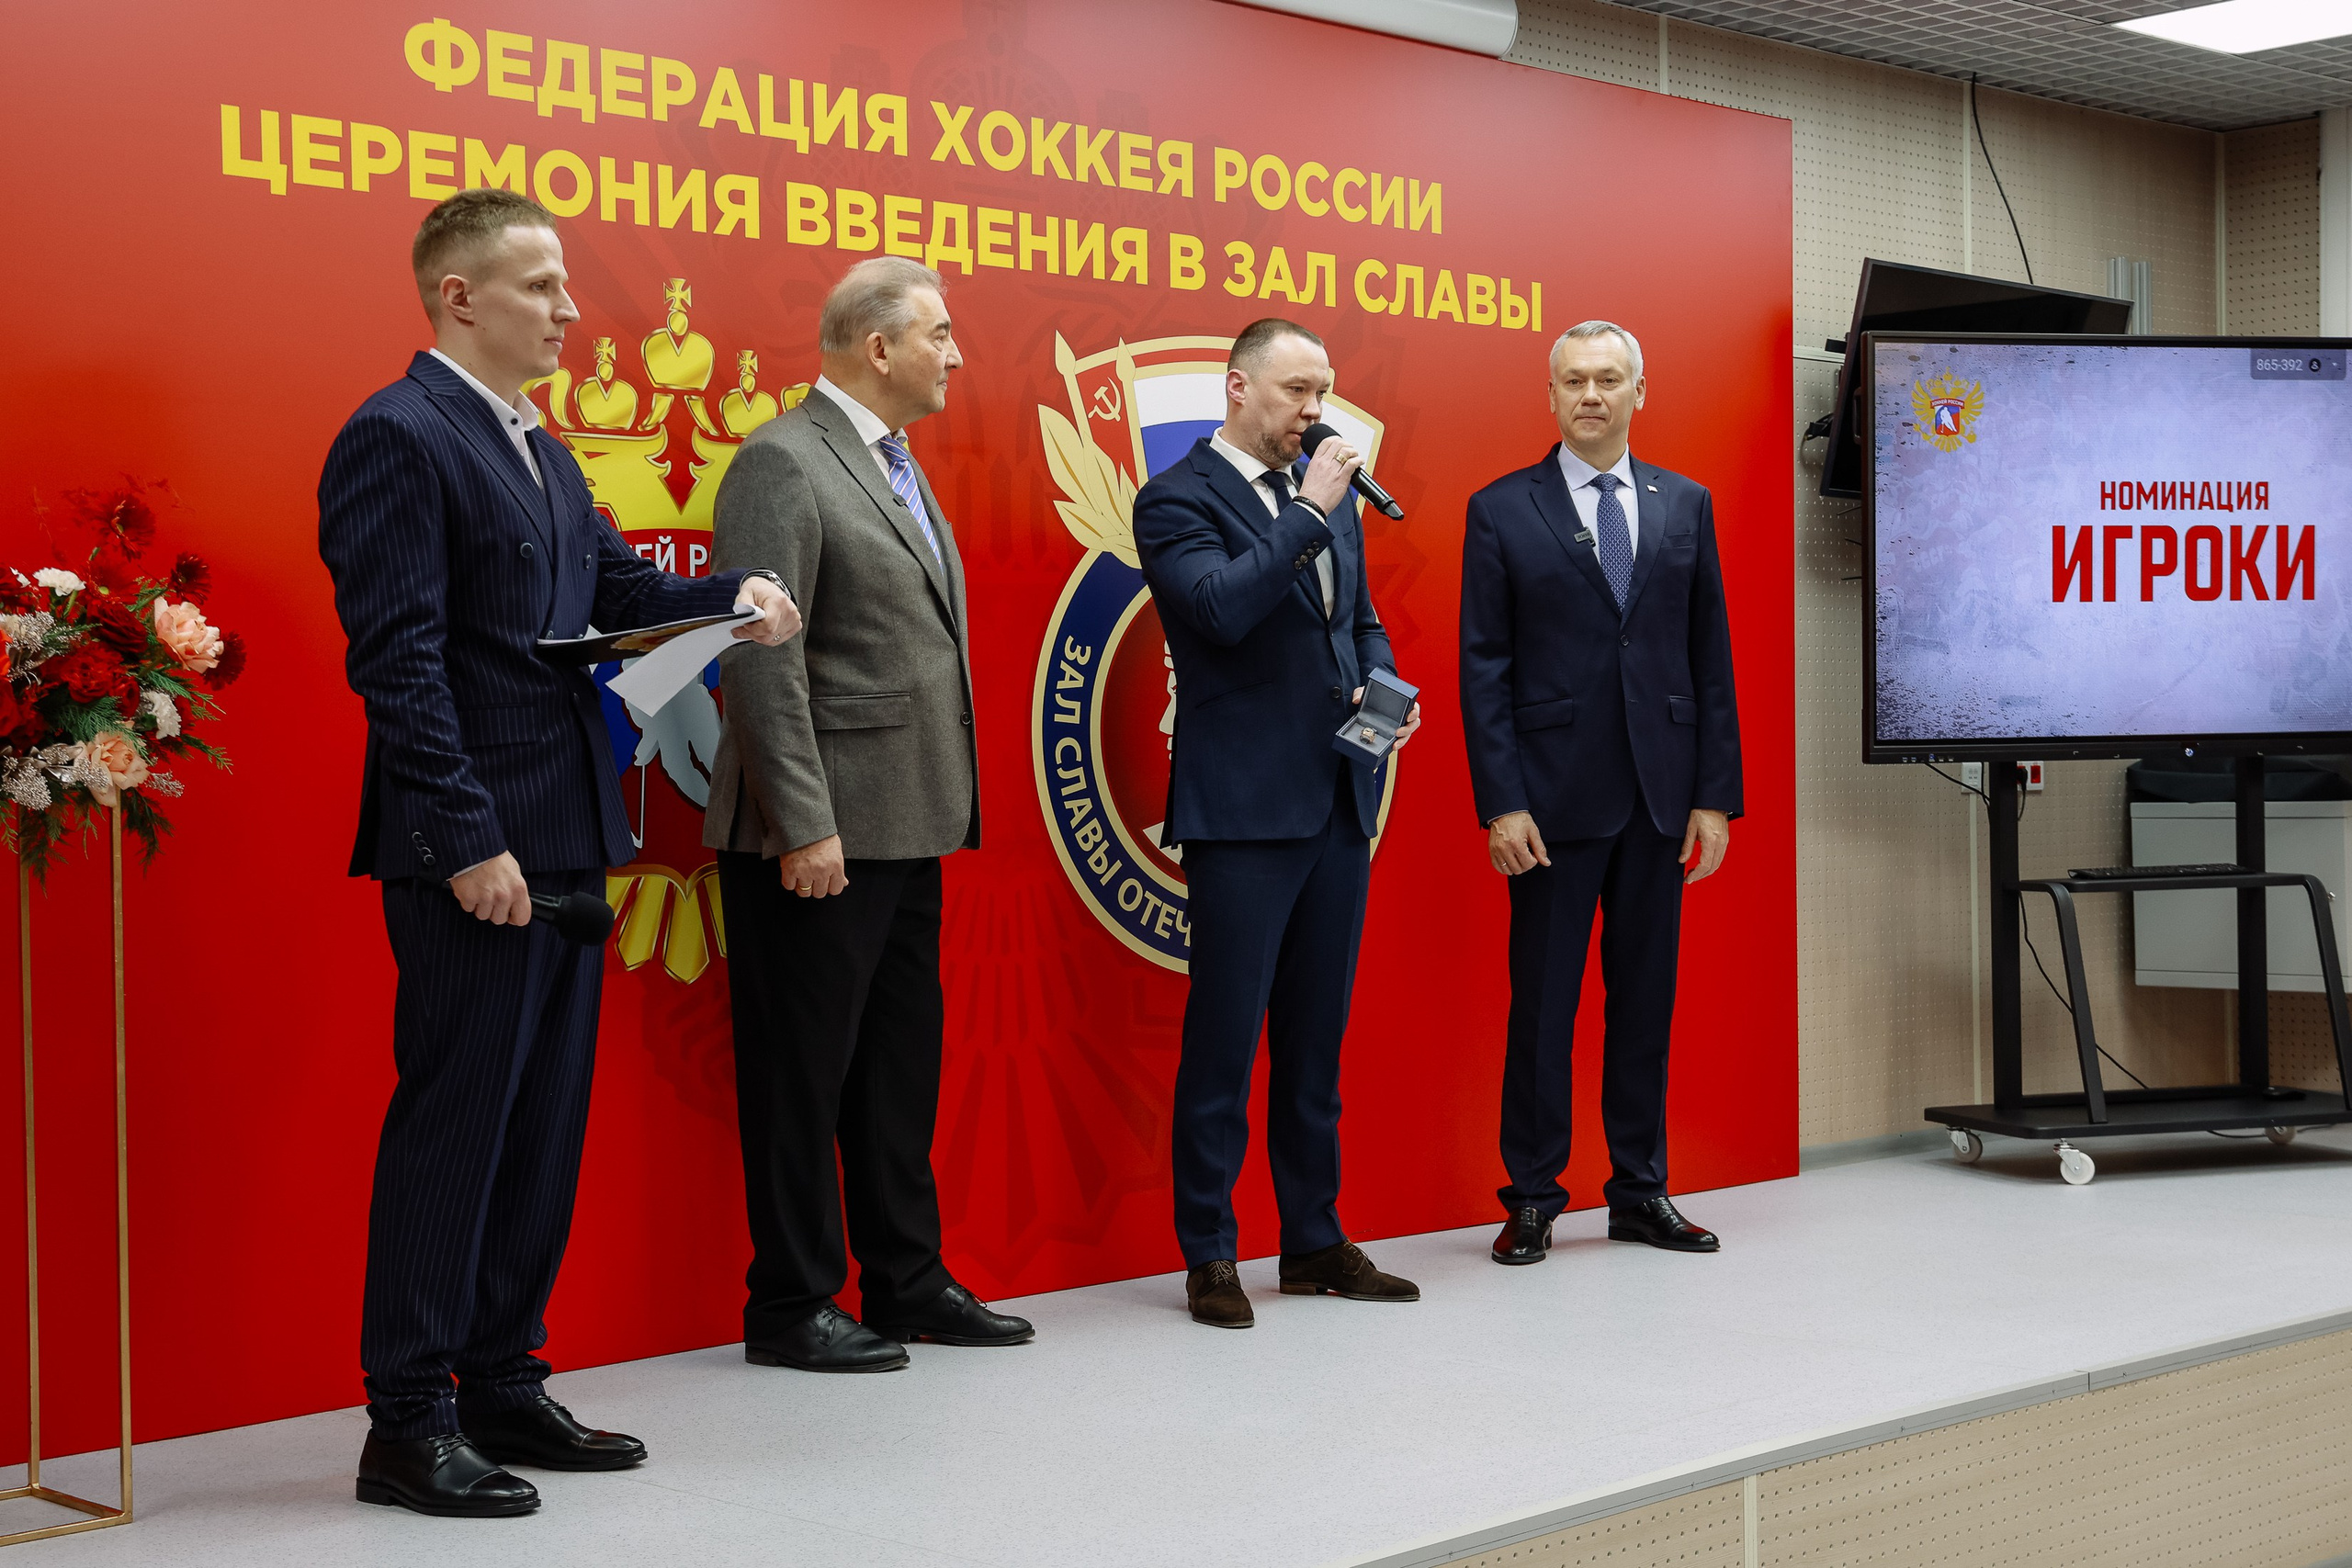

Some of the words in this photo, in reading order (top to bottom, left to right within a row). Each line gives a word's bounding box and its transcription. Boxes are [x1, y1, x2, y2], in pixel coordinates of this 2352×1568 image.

[405, 18, 908, 156] ФЕДЕРАЦИЯ
[930, 101, 1193, 198] ХОККЕЯ
[1215, 147, 1442, 234] РОССИИ
[221, 105, 760, 239] ЦЕРЕМОНИЯ
[786, 183, 1148, 285] ВВЕДЕНИЯ
[1170, 233, 1206, 290] В
[1223, 241, 1337, 307] ЗАЛ
[1354, 259, 1543, 333] СЛАВЫ
[2256, 358, 2303, 371] 865-392
[2100, 481, 2269, 513] НОМИНАЦИЯ
[2052, 525, 2315, 603] ИГРОКИ
[1054, 635, 1091, 725] ЗАЛ
[1055, 737, 1123, 886] СЛАВЫ
